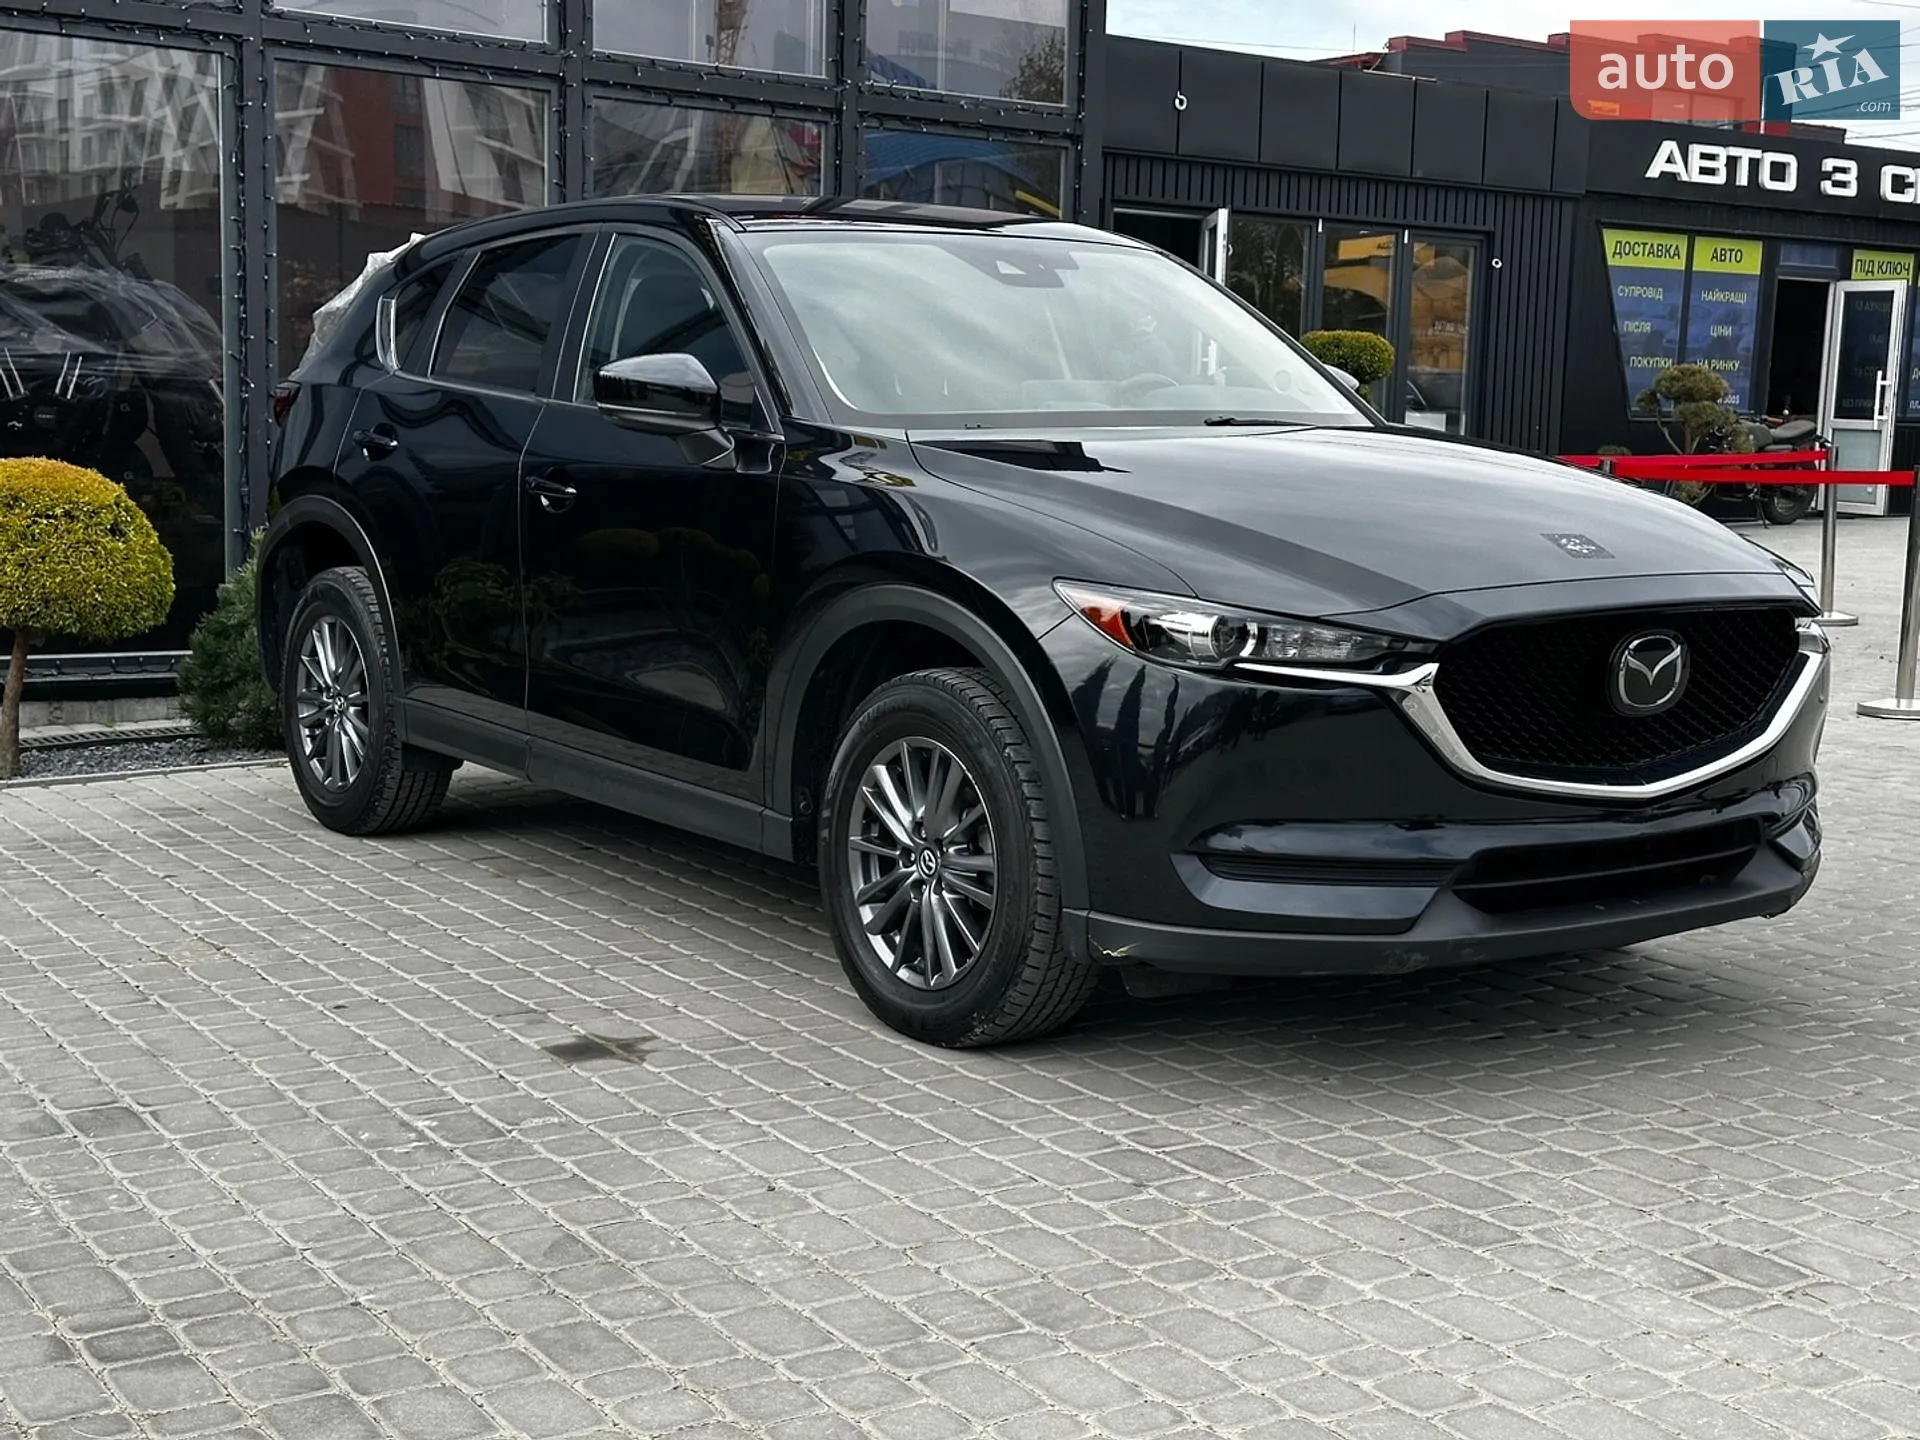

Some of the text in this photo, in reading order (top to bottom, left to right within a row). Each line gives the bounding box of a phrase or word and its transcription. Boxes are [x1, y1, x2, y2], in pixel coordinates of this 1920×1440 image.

[1644, 140, 1798, 192] АВТО
[1612, 240, 1681, 260] ДОСТАВКА
[1710, 247, 1743, 264] АВТО
[1855, 258, 1911, 277] ПІД КЛЮЧ
[1617, 284, 1664, 301] СУПРОВІД
[1701, 289, 1747, 305] НАЙКРАЩІ
[1623, 320, 1652, 333] ПІСЛЯ
[1710, 323, 1733, 338] ЦІНИ
[1629, 355, 1673, 369] ПОКУПКИ
[1710, 359, 1740, 371] РИНКУ
